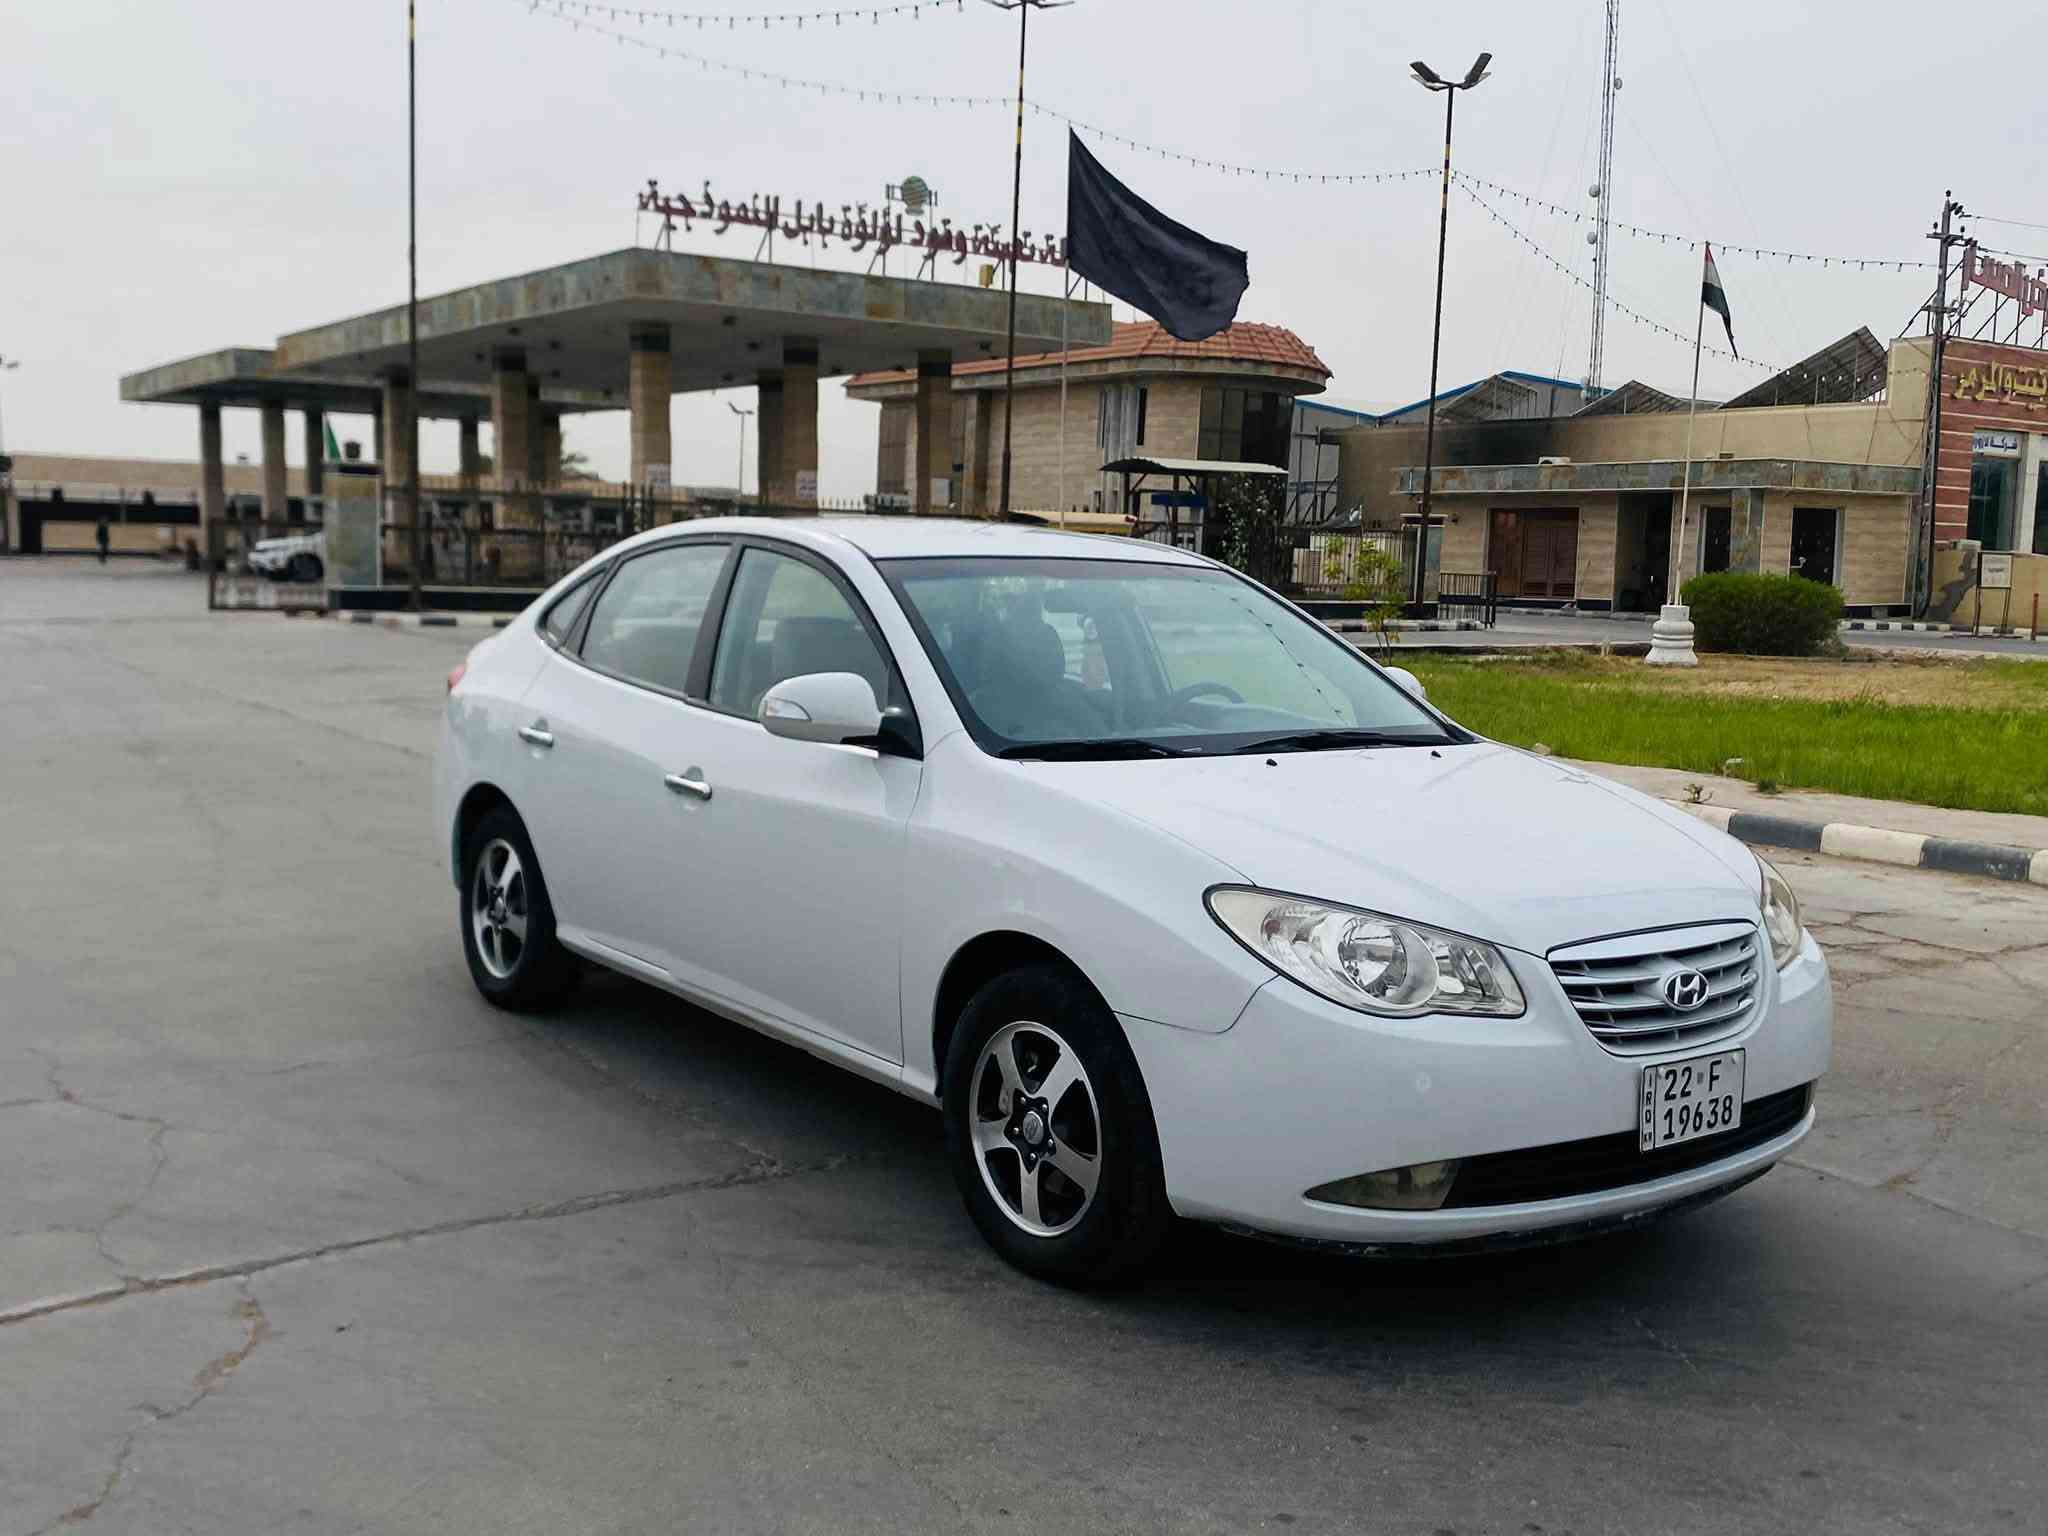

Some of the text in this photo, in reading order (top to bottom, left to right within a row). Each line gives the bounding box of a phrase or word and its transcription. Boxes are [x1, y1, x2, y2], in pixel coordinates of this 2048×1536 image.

[638, 179, 779, 235] النموذجية
[783, 200, 834, 248] بابل
[910, 218, 967, 265] وقود
[1664, 1060, 1722, 1101] 22 F
[1663, 1095, 1733, 1140] 19638
